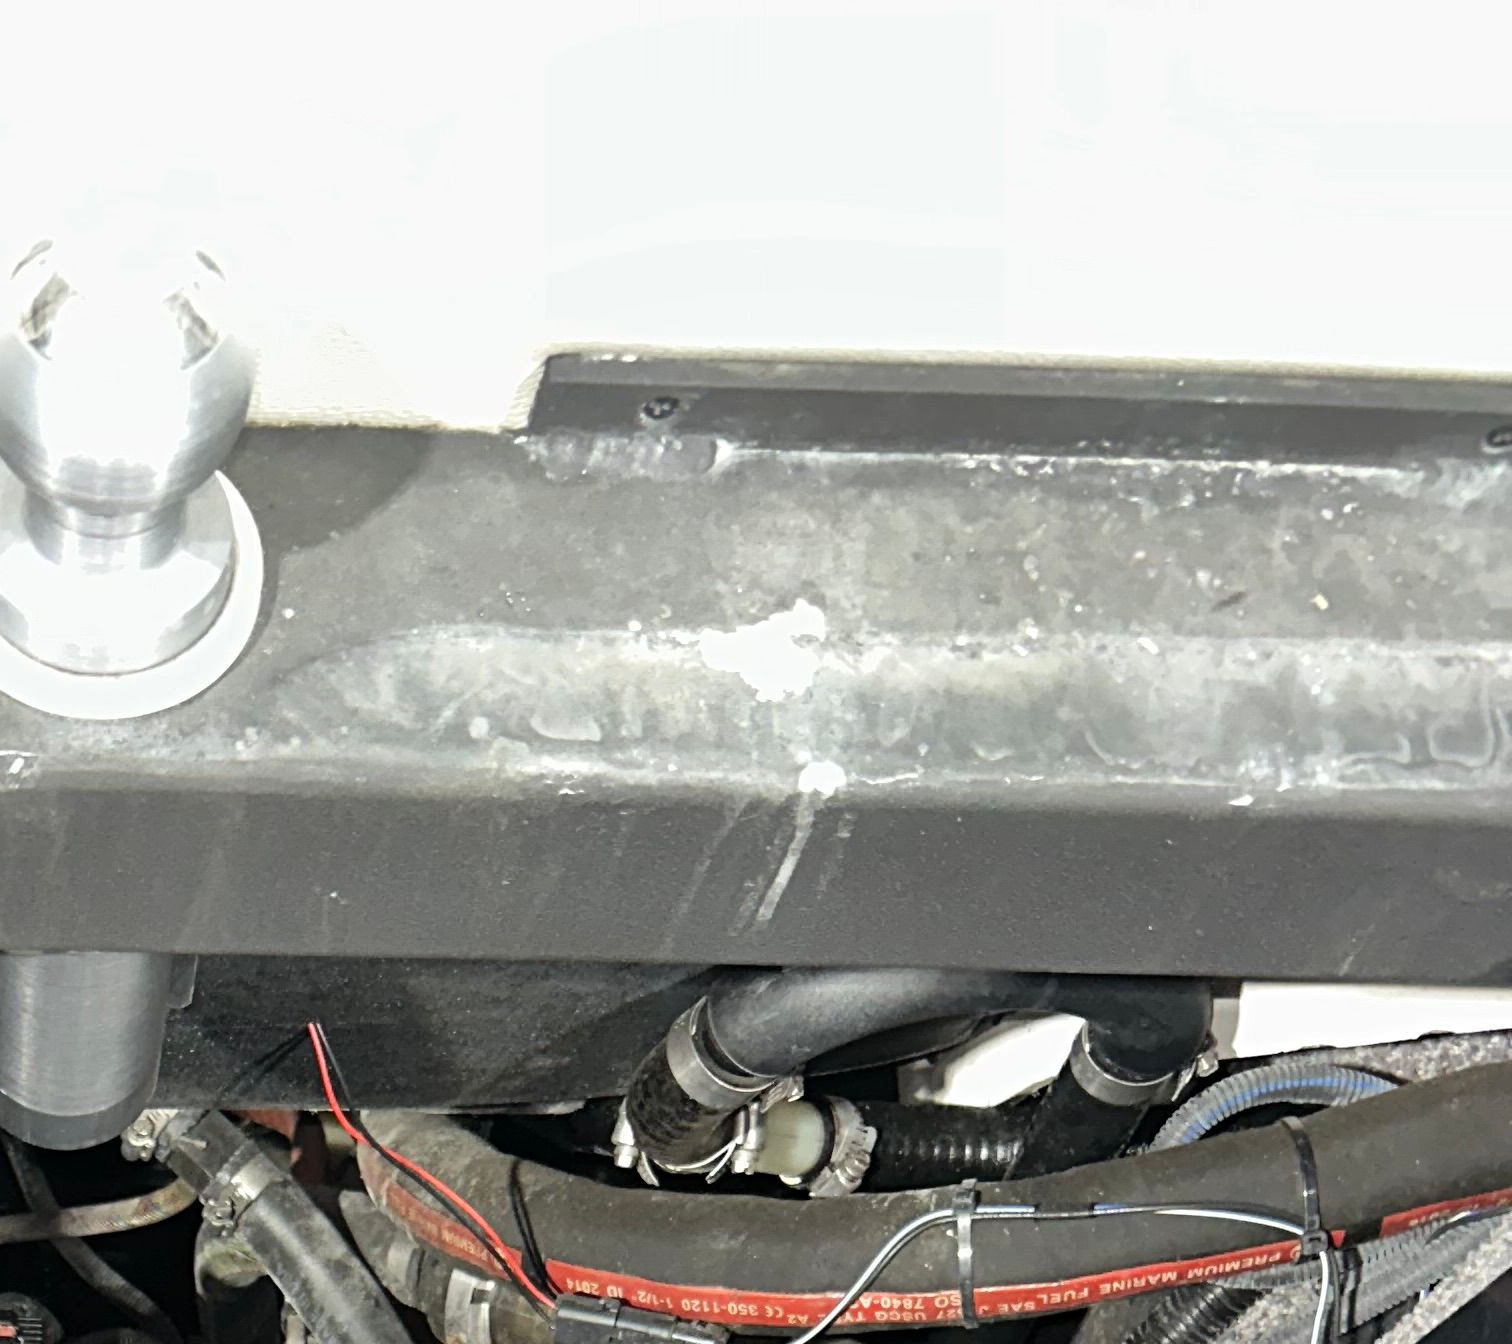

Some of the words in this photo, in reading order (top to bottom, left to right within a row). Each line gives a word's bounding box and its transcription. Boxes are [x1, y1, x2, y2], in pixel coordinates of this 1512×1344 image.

[1187, 1251, 1282, 1280] PREMIUM
[565, 1276, 600, 1295] 2014
[606, 1284, 623, 1299] ID
[1099, 1270, 1178, 1296] MARINE
[1036, 1287, 1089, 1304] FUEL
[681, 1298, 760, 1317] 350-1120
[997, 1301, 1036, 1313] SAE
